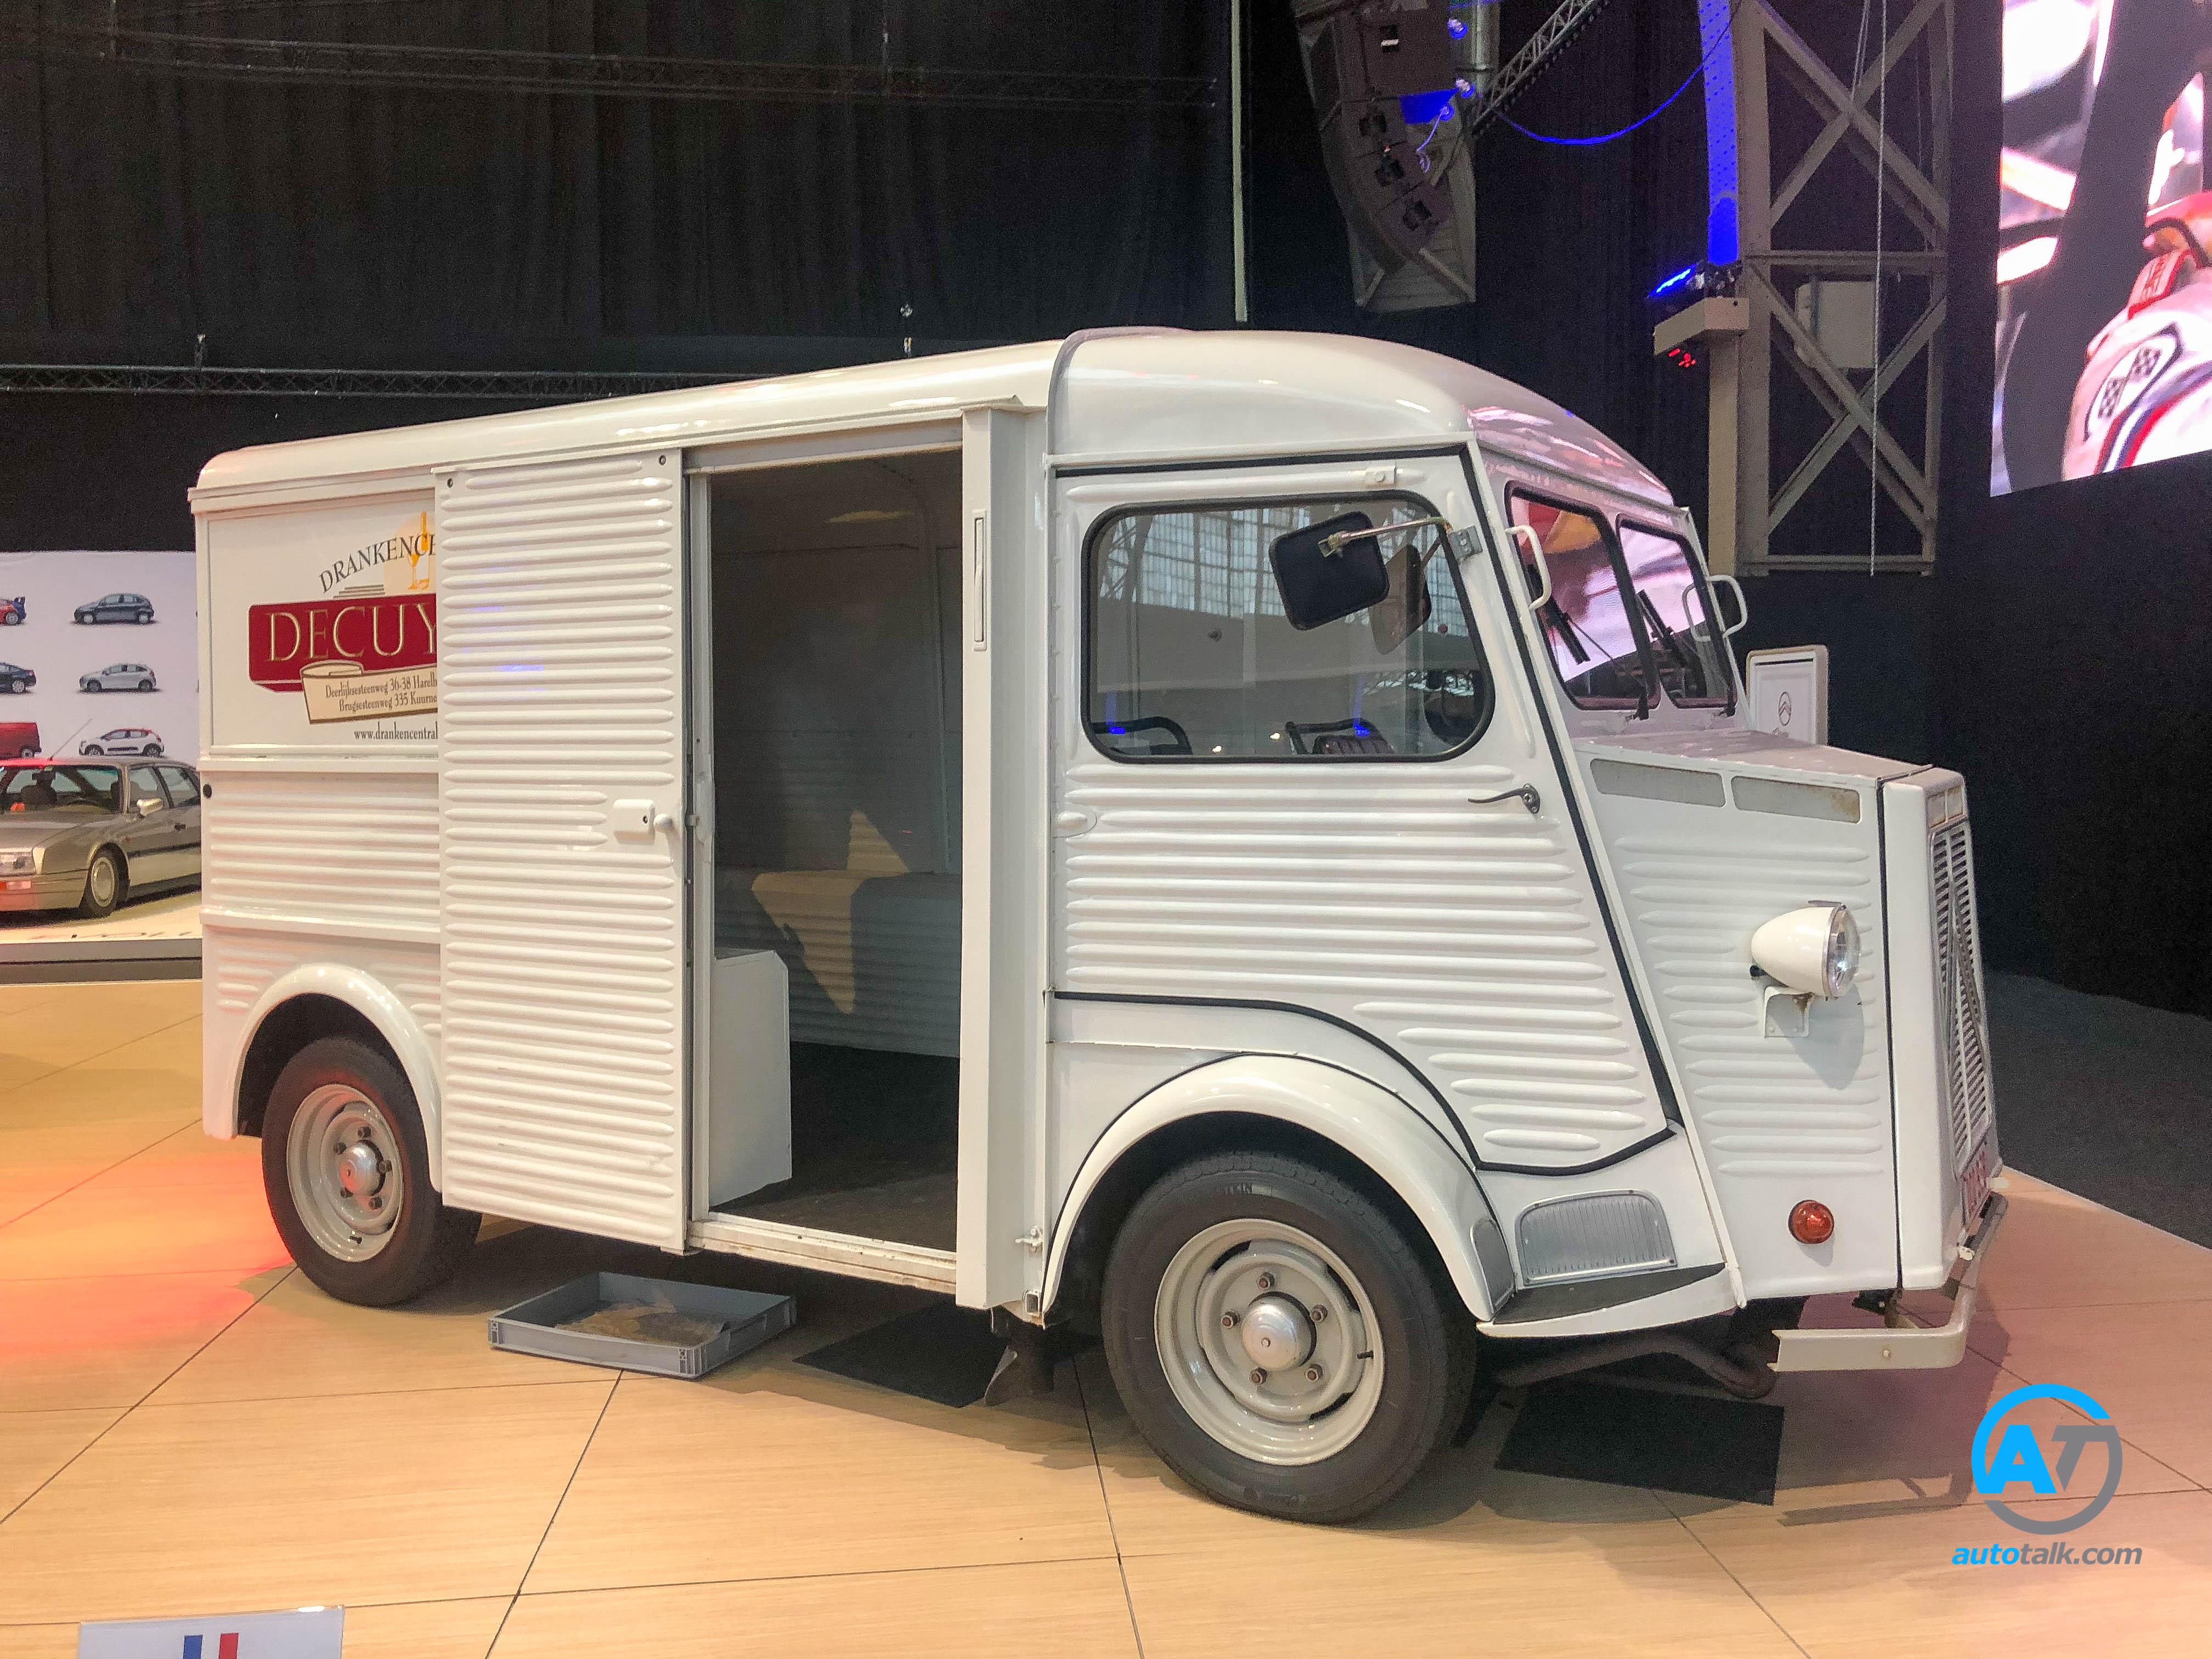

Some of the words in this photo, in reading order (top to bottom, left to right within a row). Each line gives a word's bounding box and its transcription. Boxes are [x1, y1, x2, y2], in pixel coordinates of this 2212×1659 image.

[325, 680, 388, 699] Deerlijksesteenweg
[390, 676, 411, 691] 36-38
[339, 697, 393, 713] Brugsesteenweg
[394, 692, 409, 706] 335
[410, 691, 437, 705] Kuurne
